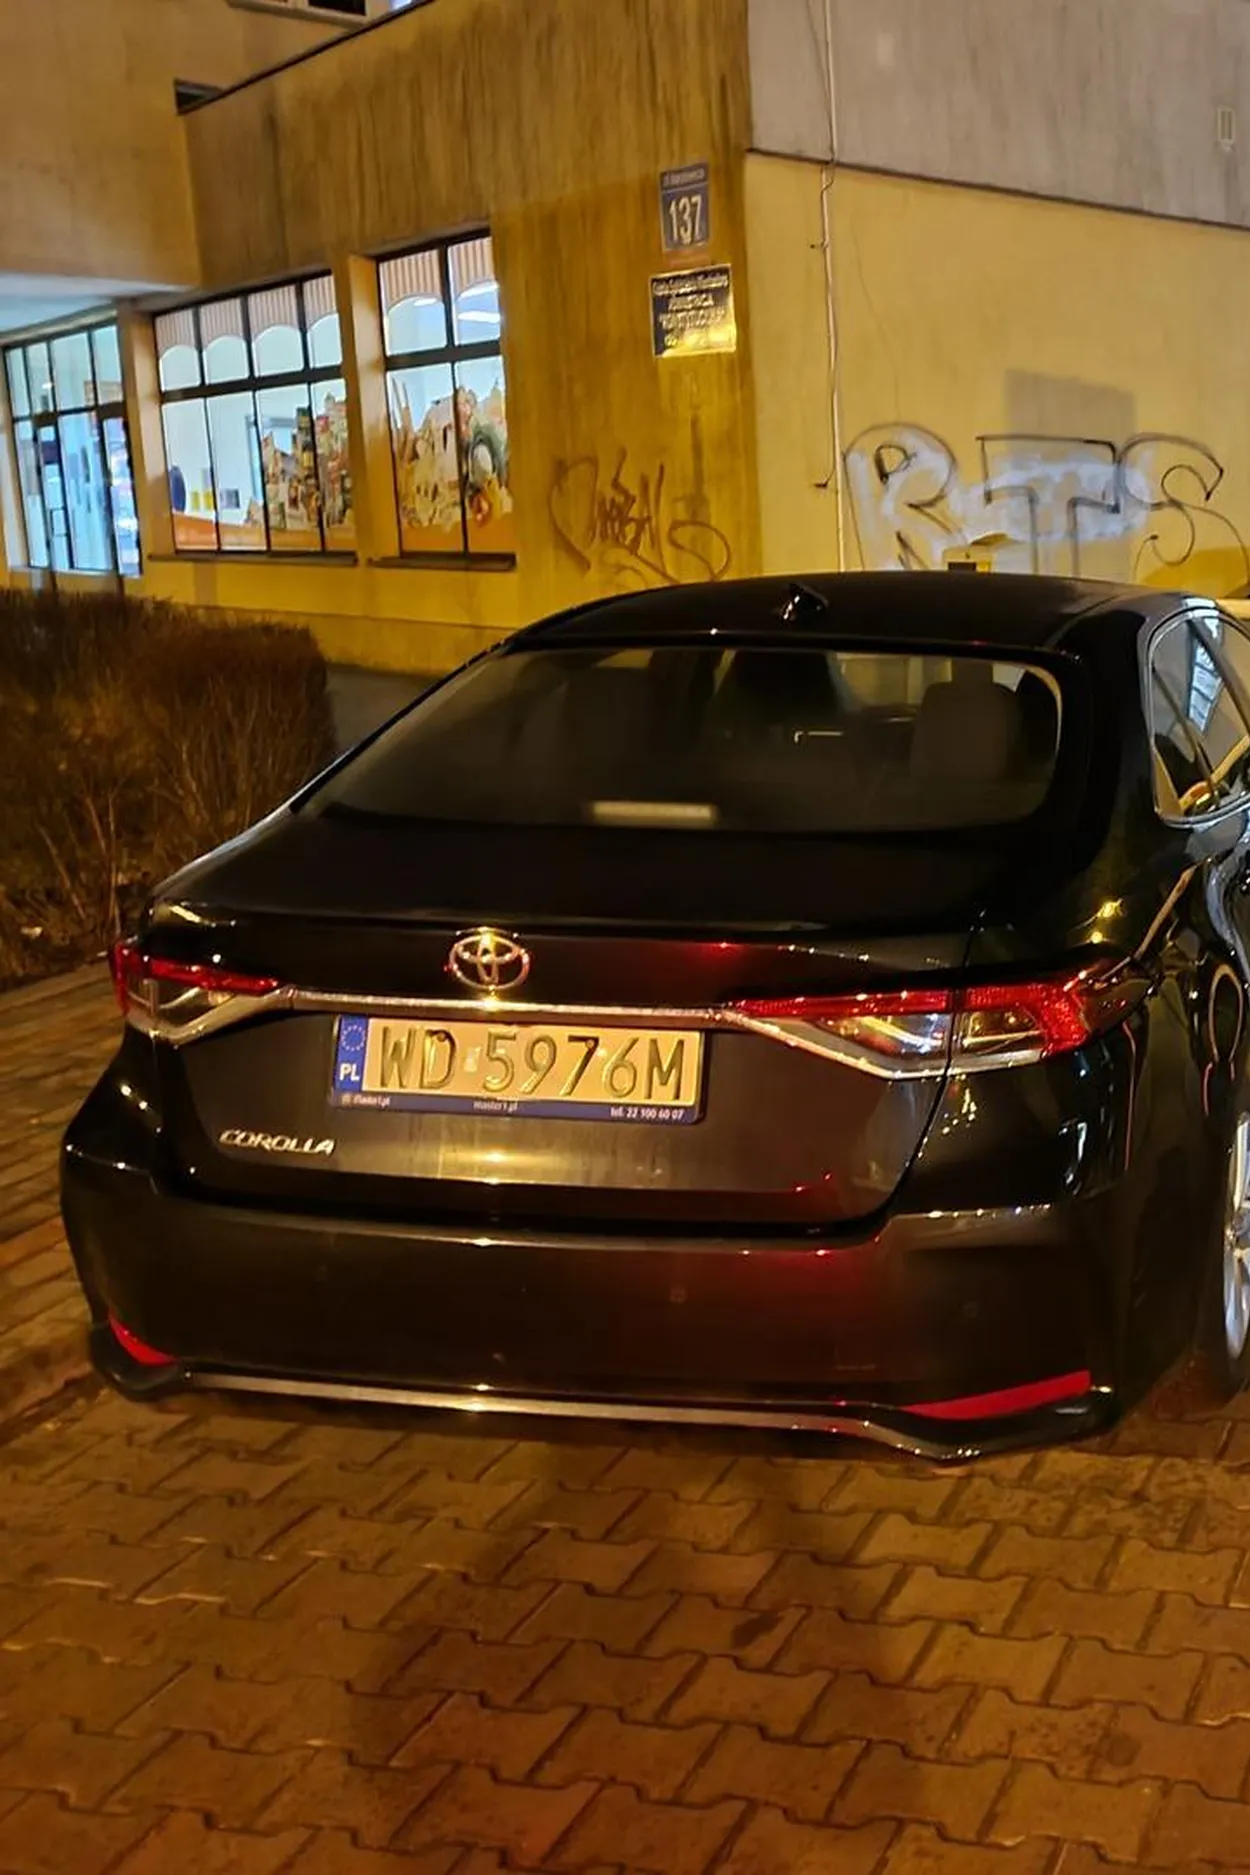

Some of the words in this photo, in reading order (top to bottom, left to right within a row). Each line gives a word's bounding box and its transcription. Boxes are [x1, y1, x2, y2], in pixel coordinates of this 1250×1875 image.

[668, 194, 703, 245] 137
[339, 1063, 360, 1081] PL
[379, 1026, 457, 1090] WD
[483, 1027, 686, 1100] 5976M
[219, 1129, 336, 1156] COROLLA
